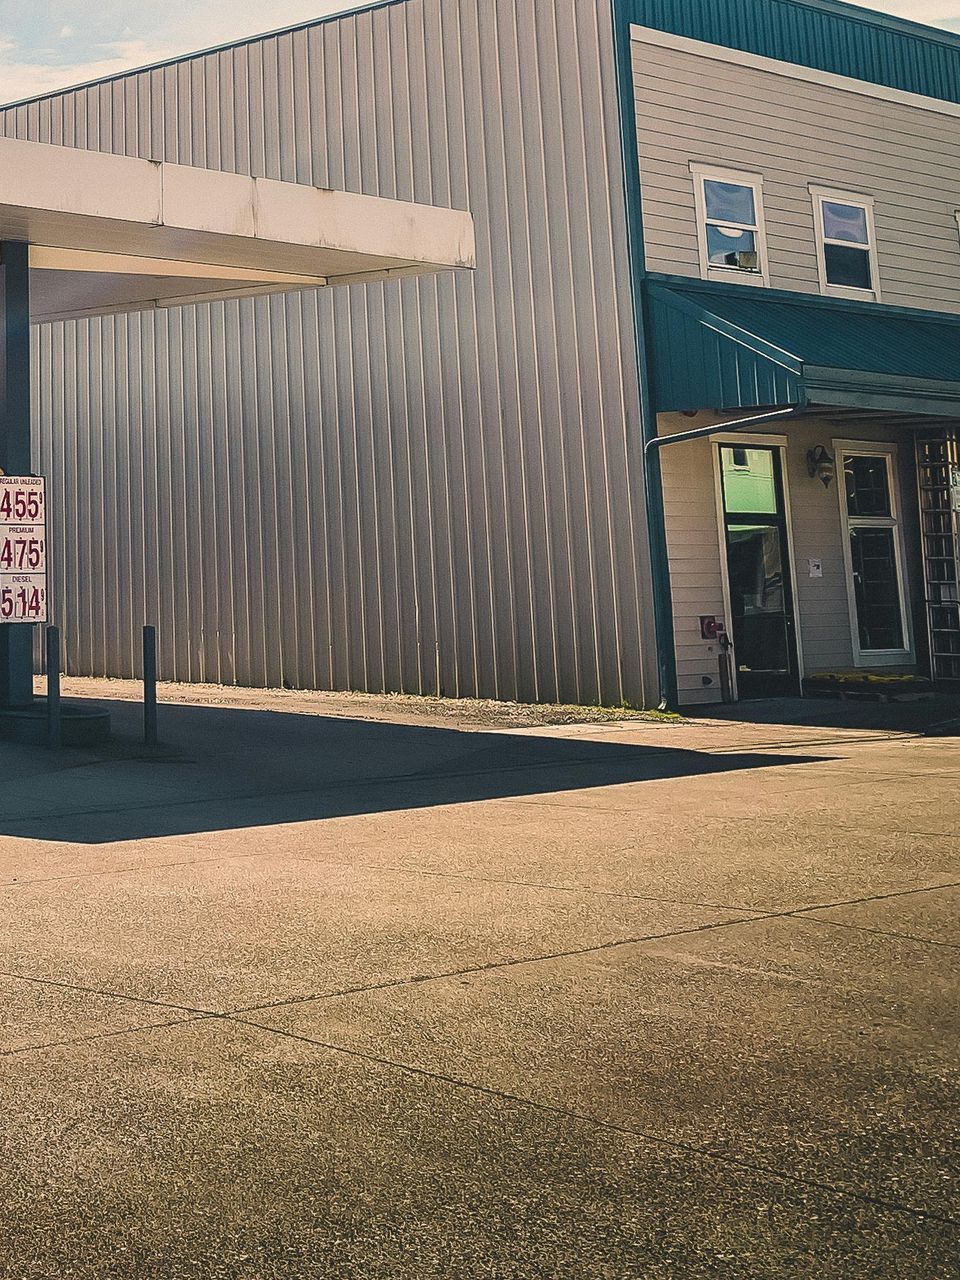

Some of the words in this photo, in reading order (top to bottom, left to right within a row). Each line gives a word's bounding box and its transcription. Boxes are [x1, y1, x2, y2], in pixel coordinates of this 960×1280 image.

[0, 491, 39, 518] 455
[0, 540, 40, 567] 475
[1, 588, 41, 617] 514
